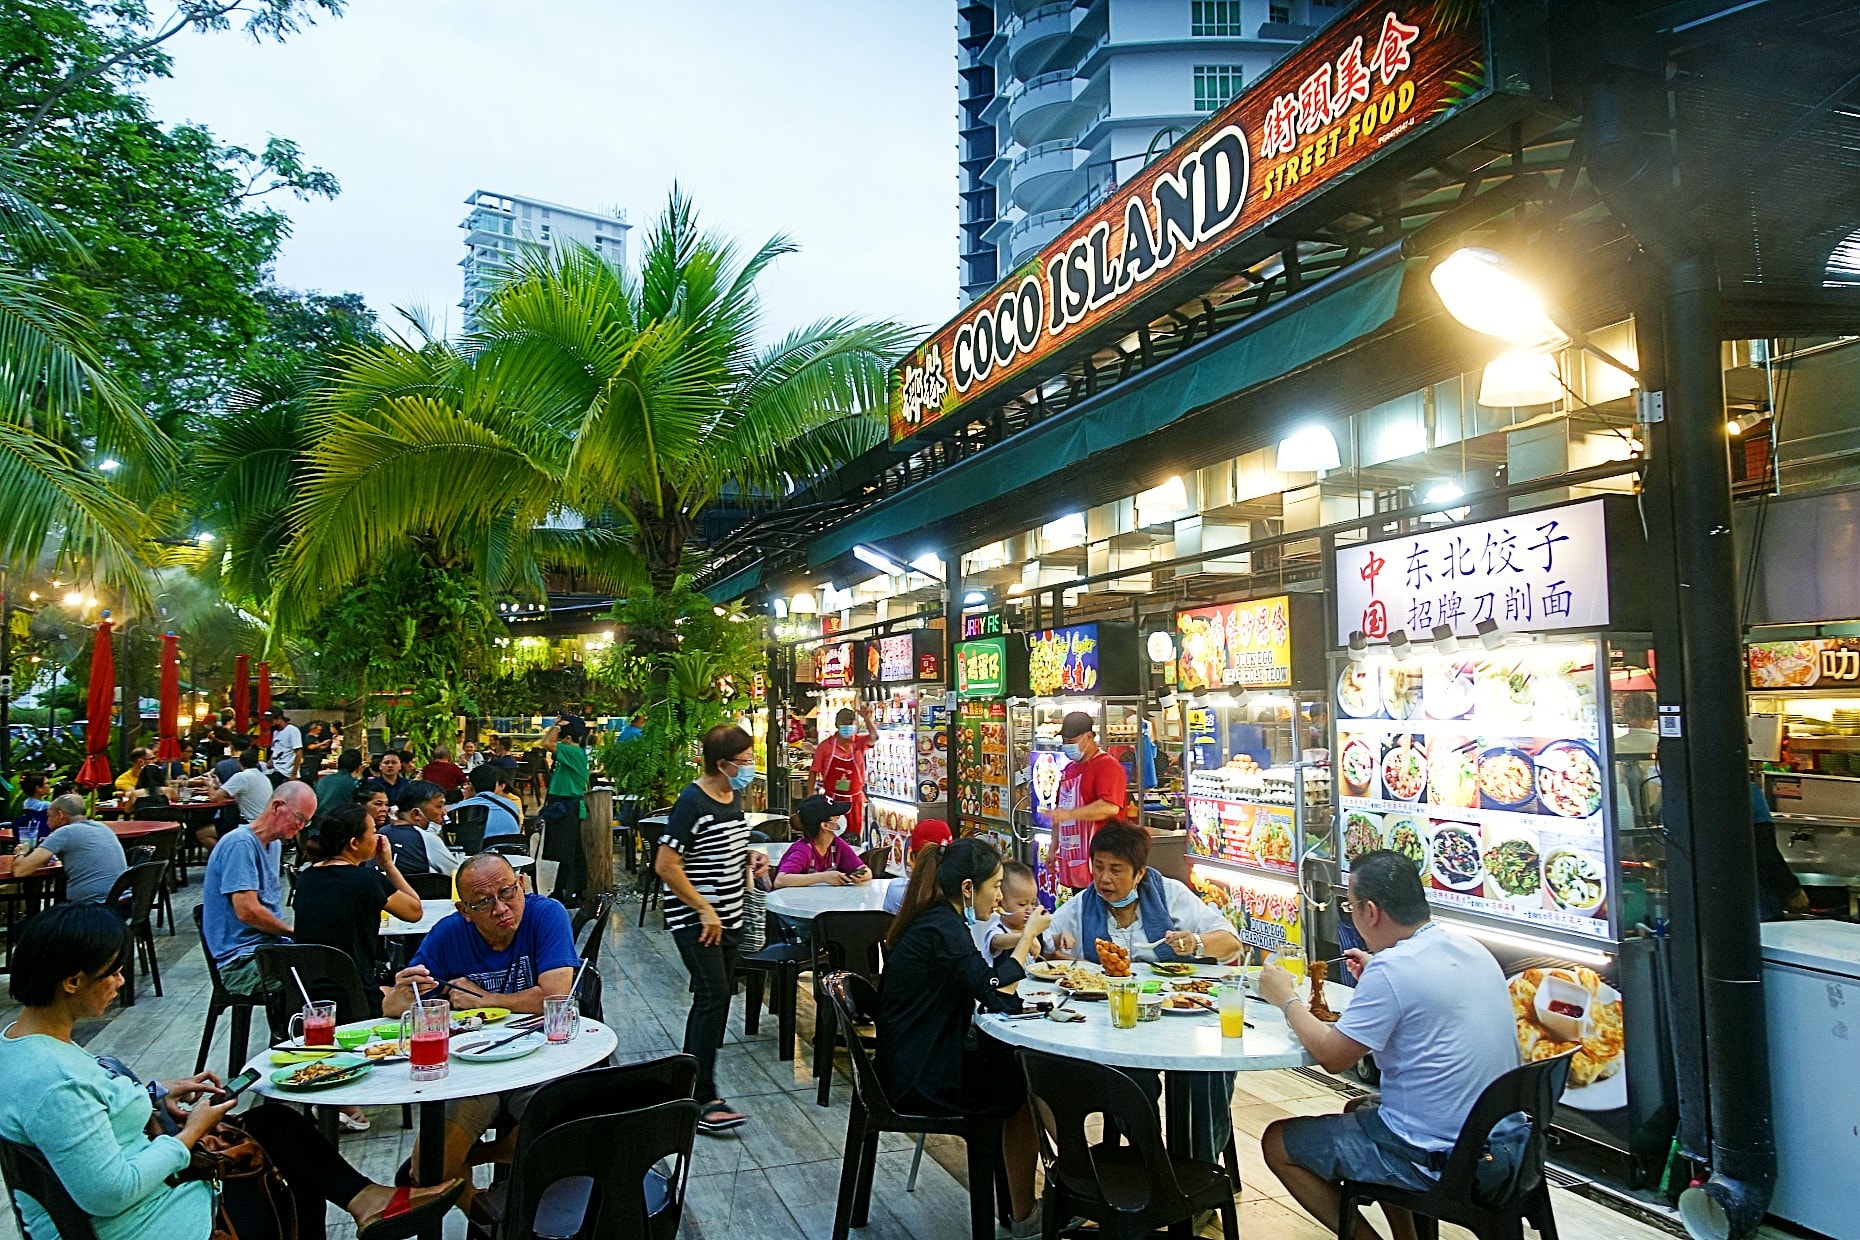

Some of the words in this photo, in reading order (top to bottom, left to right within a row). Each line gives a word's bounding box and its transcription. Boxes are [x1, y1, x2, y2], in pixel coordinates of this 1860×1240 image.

[1261, 11, 1419, 159] 街頭美食
[1262, 126, 1341, 200] STREET
[1348, 80, 1415, 146] FOOD
[952, 275, 1042, 393] COCO
[1048, 124, 1250, 335] ISLAND
[1406, 520, 1569, 590] 东北饺子
[1359, 551, 1388, 638] 中国
[1407, 580, 1573, 632] 招牌刀削面
[1235, 651, 1257, 667] DUCK
[1257, 650, 1274, 666] EGG
[1264, 666, 1288, 682] TEOW
[1250, 918, 1271, 936] DUCK
[1270, 923, 1286, 939] EGG
